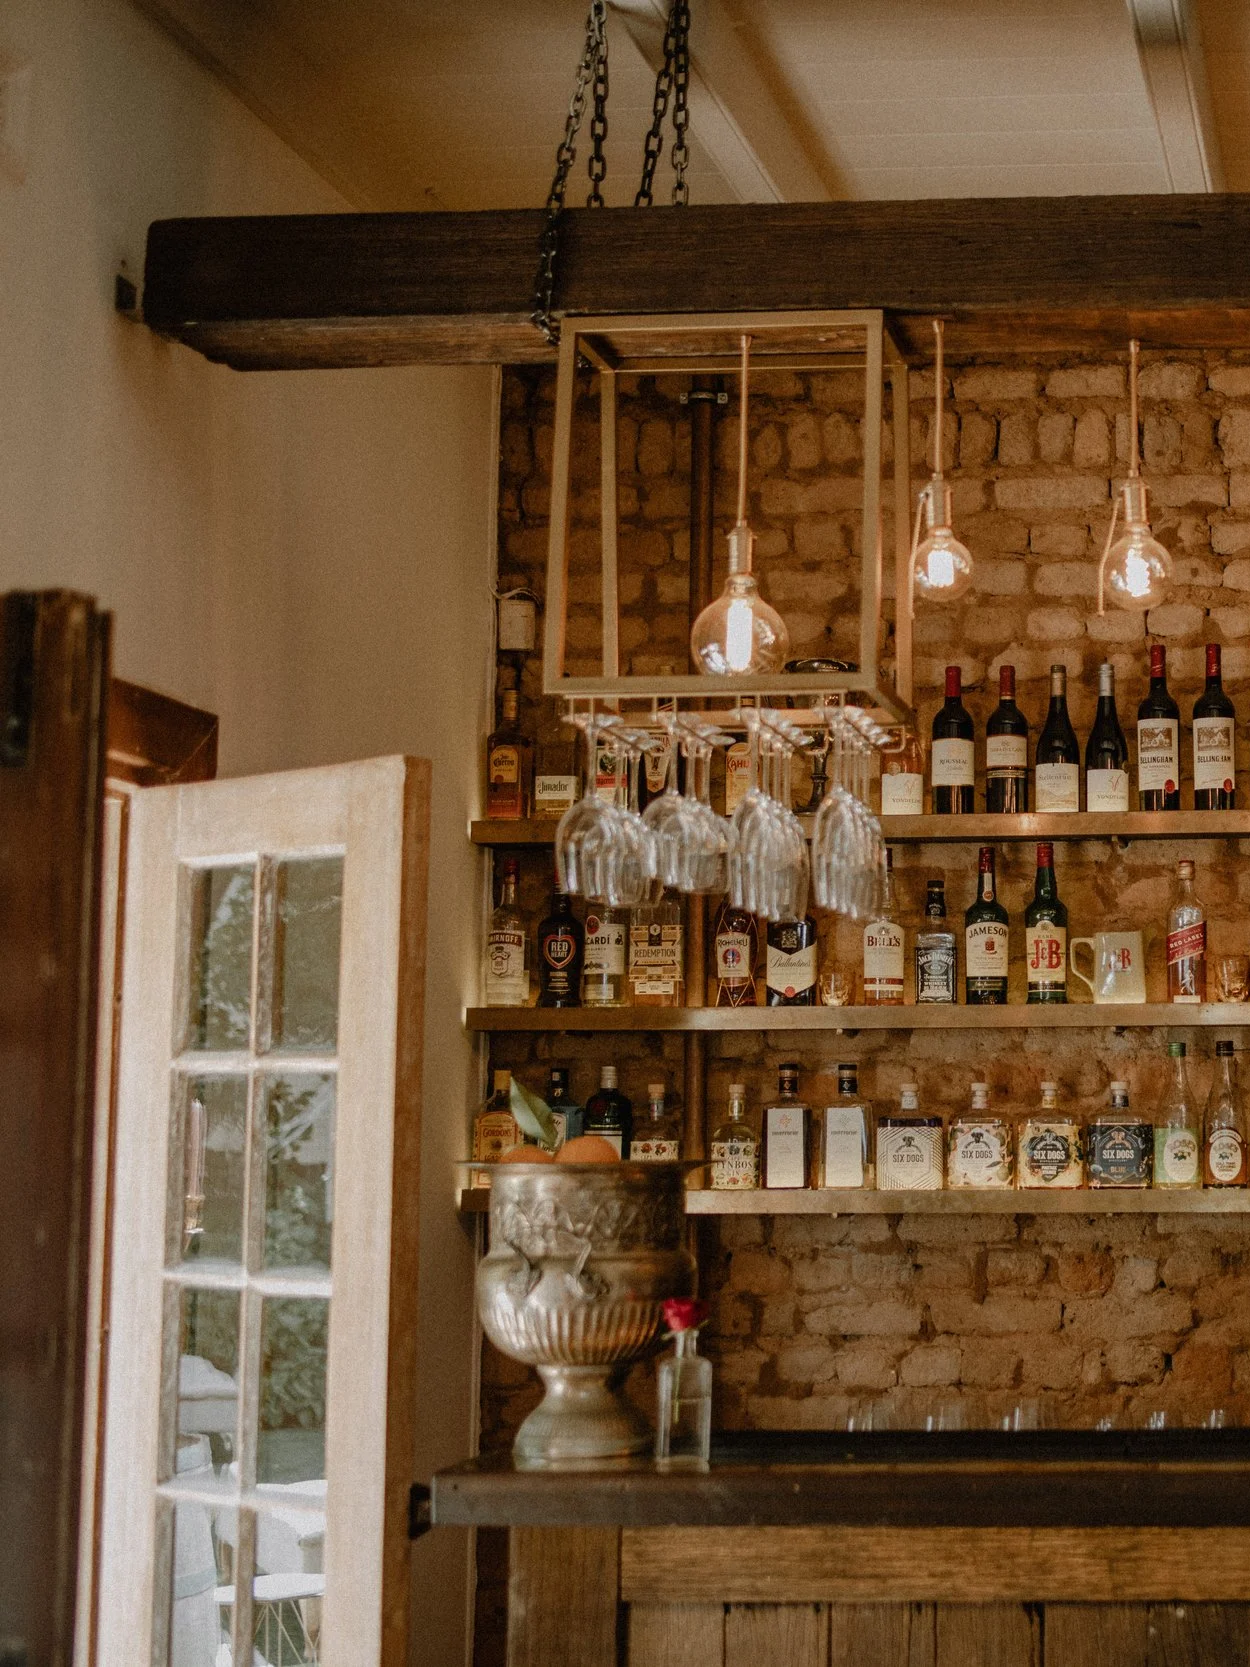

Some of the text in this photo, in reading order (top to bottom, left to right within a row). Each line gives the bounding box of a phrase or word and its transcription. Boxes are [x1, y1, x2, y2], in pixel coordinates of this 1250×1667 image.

[539, 781, 569, 794] Jimador
[968, 925, 1008, 939] JAMESON
[585, 934, 610, 945] CARDÍ
[1170, 932, 1204, 949] RED LABEL
[551, 941, 569, 951] RED
[634, 948, 676, 958] REDEMPTION
[1030, 939, 1062, 969] J&B
[892, 1154, 925, 1163] SIX DOGS
[961, 1150, 993, 1159] SIX DOGS
[1033, 1150, 1066, 1160] SIX DOGS
[1102, 1150, 1135, 1159] SIX DOGS
